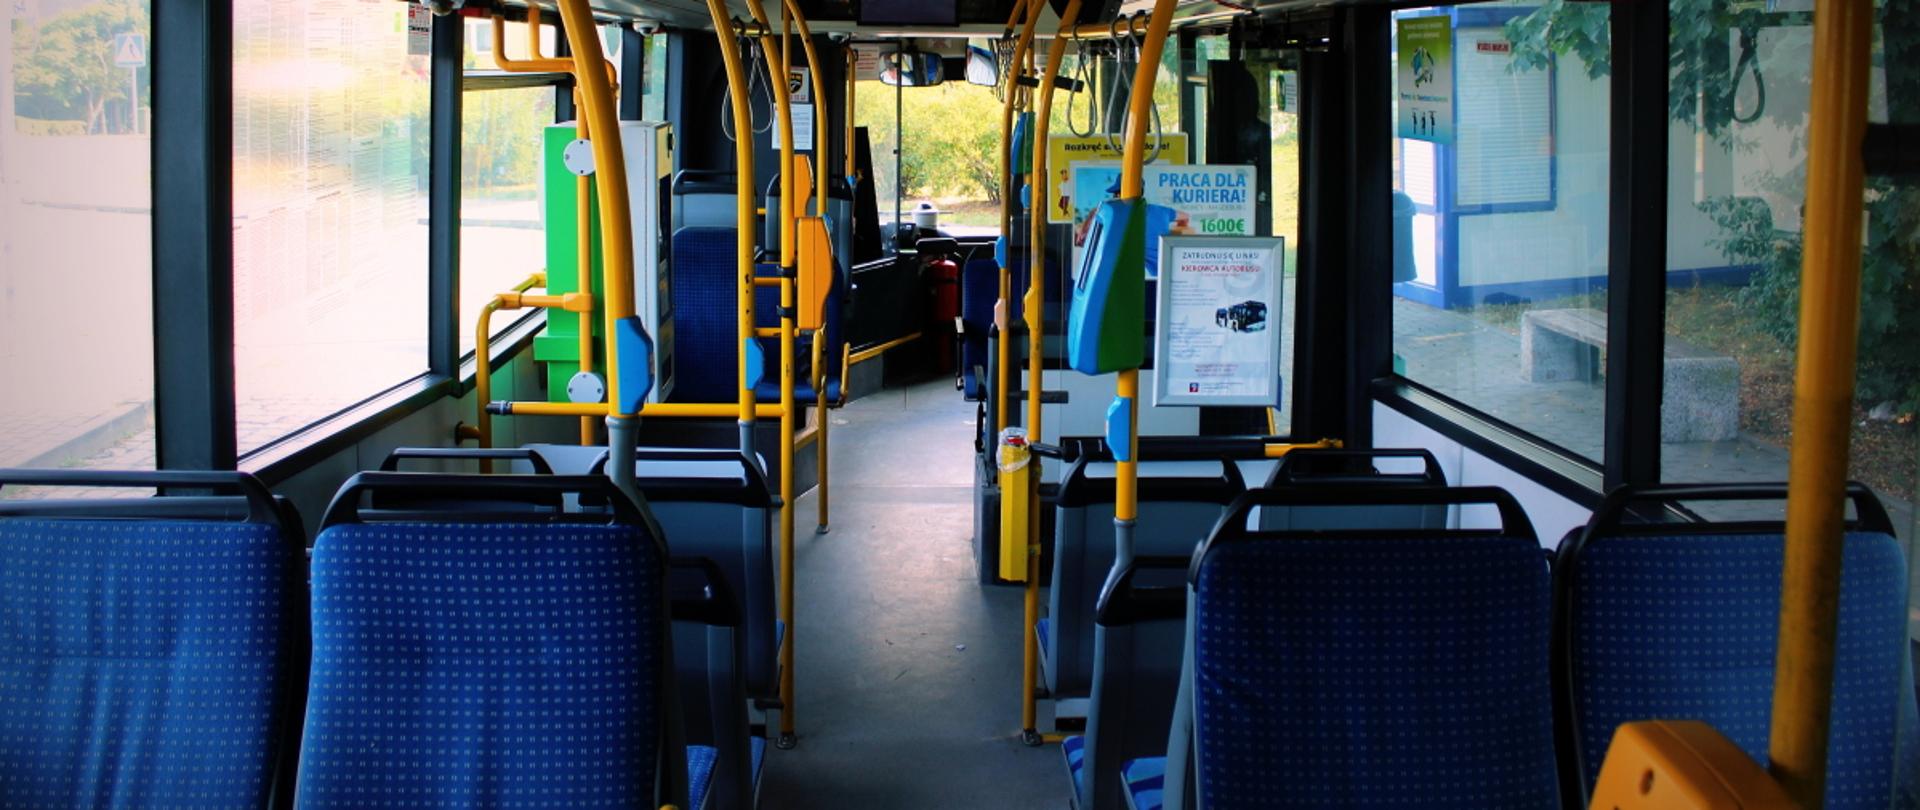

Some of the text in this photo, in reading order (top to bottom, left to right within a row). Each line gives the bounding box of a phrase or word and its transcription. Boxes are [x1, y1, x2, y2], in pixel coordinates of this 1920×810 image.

[1158, 172, 1246, 187] PRACA DLA
[1172, 189, 1246, 203] KURIERA!
[1200, 218, 1245, 232] 1600€
